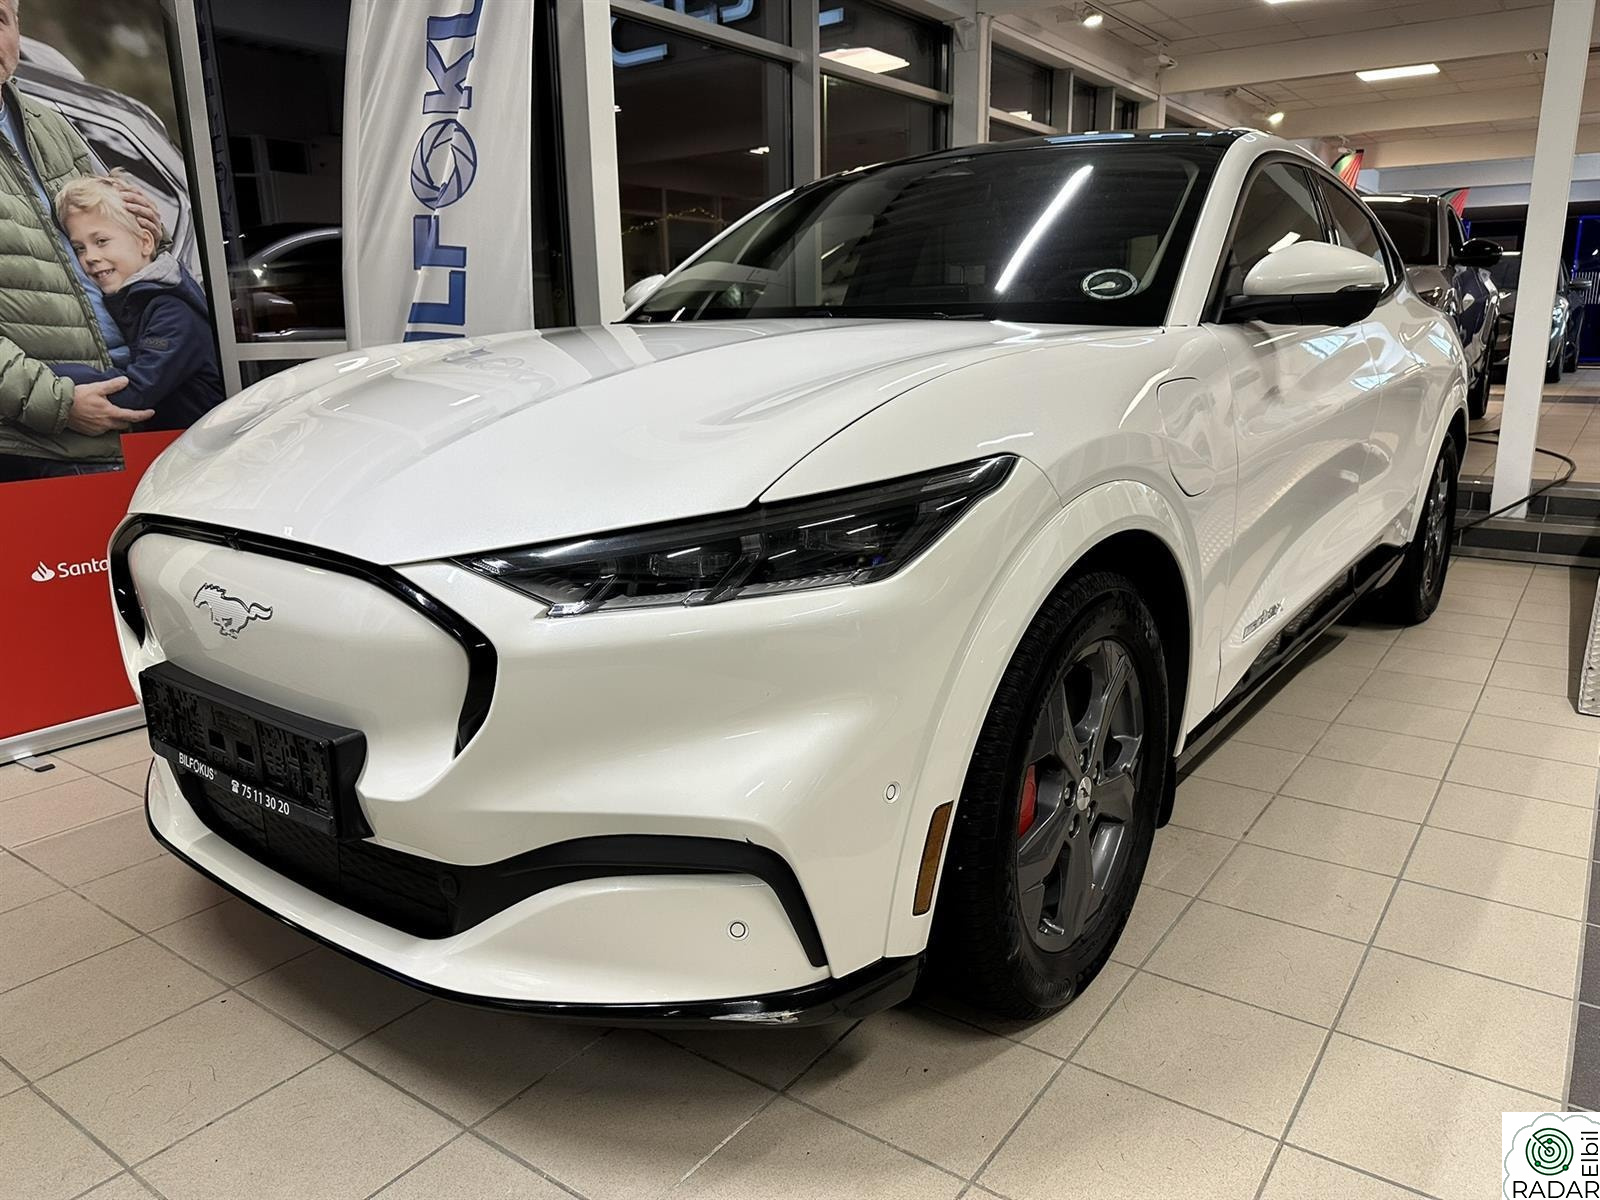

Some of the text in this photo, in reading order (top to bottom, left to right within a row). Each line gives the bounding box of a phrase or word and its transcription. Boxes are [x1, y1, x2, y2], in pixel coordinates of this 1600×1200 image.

[179, 752, 290, 816] BILFOKUS 75 11 30 20
